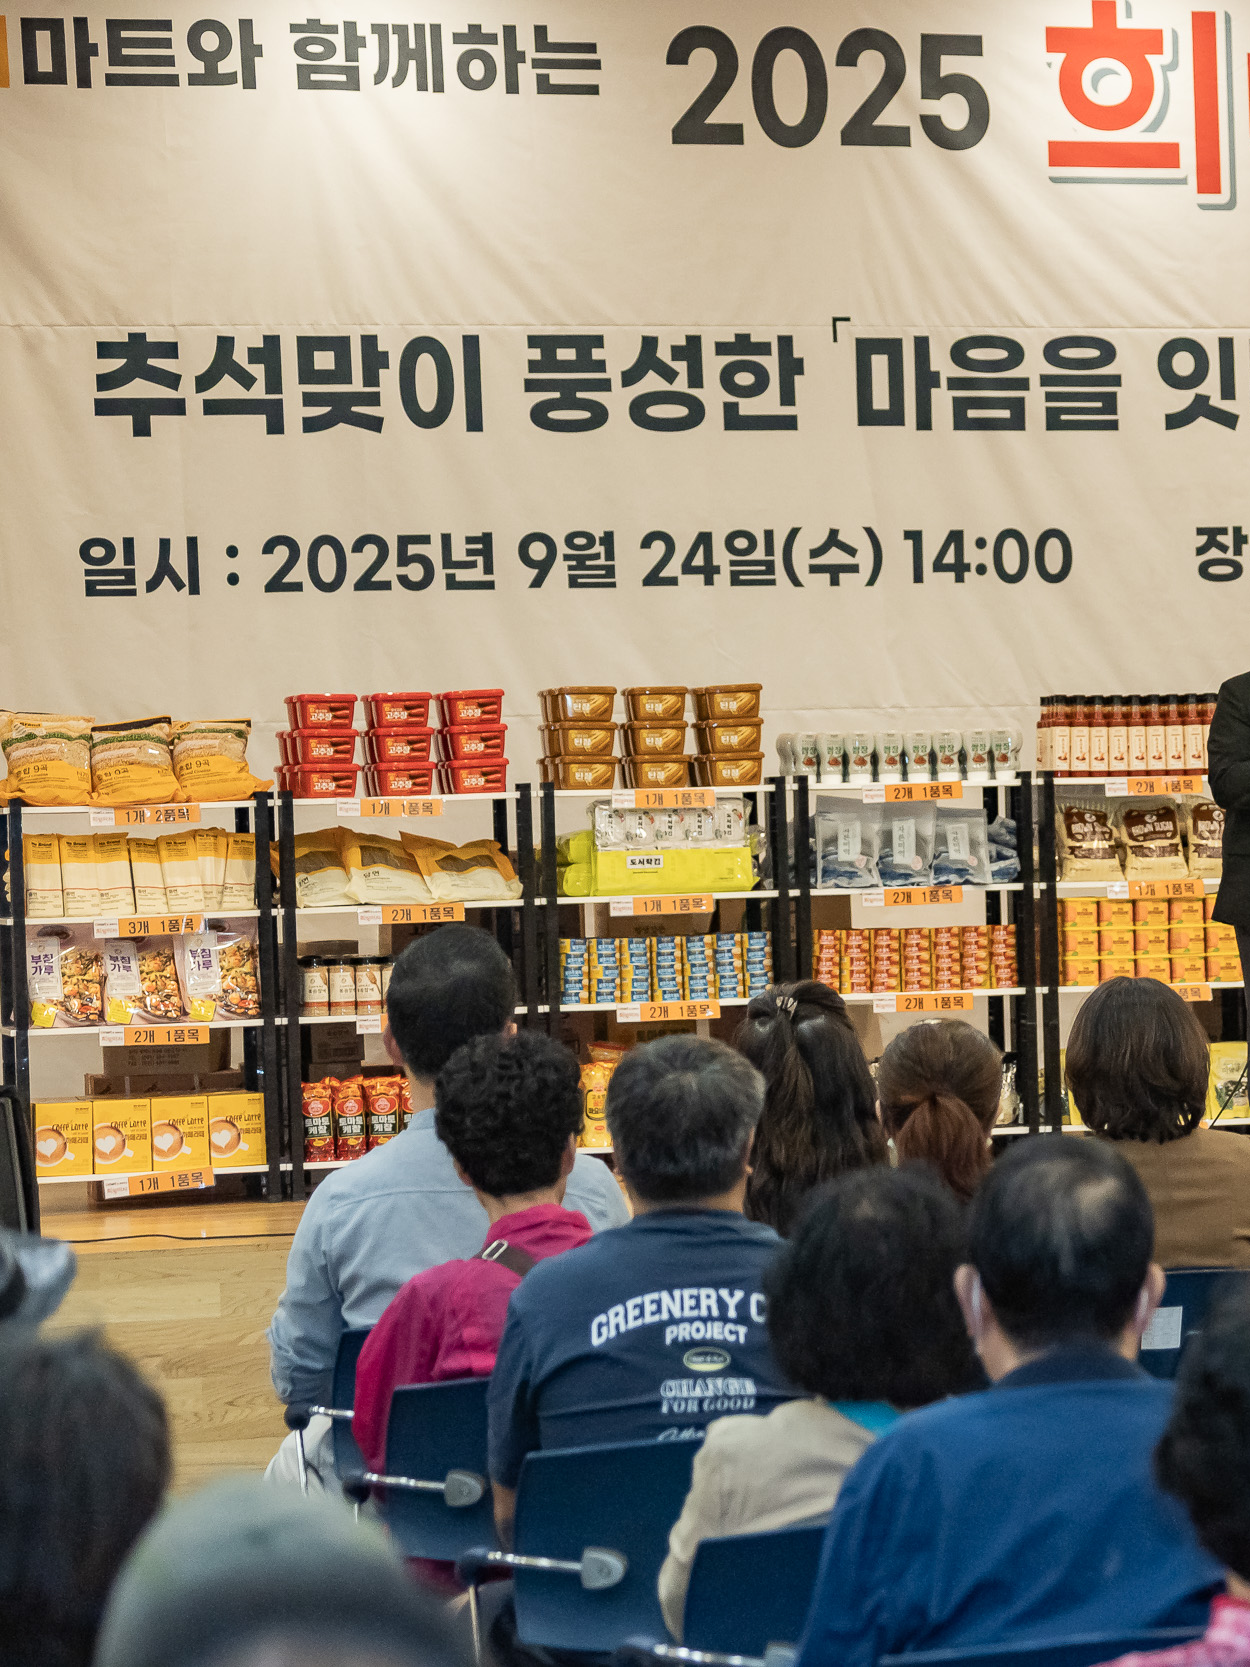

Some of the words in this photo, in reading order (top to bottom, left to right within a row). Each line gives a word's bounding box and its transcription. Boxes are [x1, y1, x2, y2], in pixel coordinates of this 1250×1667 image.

[289, 18, 601, 96] 함께하는
[665, 25, 990, 150] 2025
[93, 331, 485, 437] 추석맞이
[523, 332, 805, 433] 풍성한
[78, 535, 201, 598] 일시
[261, 531, 497, 594] 2025년
[517, 530, 618, 590] 9월
[640, 526, 883, 589] 24일(수)
[902, 528, 1074, 585] 14:00
[311, 712, 333, 722] 고추장
[386, 711, 408, 720] 고추장
[459, 708, 481, 718] 고추장
[312, 747, 334, 756] 고추장
[388, 745, 410, 755] 고추장
[462, 742, 484, 752] 고추장
[313, 781, 336, 791] 고추장
[390, 779, 412, 789] 고추장
[463, 776, 485, 786] 고추장
[1135, 780, 1155, 794] 2개
[1165, 779, 1193, 793] 1품목
[646, 793, 664, 806] 1개
[674, 792, 705, 805] 1품목
[893, 786, 913, 800] 2개
[922, 784, 953, 798] 1품목
[125, 809, 146, 824] 1개
[155, 808, 190, 823] 2품목
[371, 802, 390, 815] 1개
[401, 802, 433, 815] 1품목
[893, 891, 913, 904] 2개
[922, 889, 953, 903] 1품목
[1138, 884, 1156, 897] 1개
[1165, 882, 1195, 897] 1품목
[643, 900, 662, 913] 1개
[672, 897, 703, 911] 1품목
[391, 908, 412, 922] 2개
[421, 906, 455, 921] 1품목
[128, 920, 150, 935] 3개
[160, 918, 194, 933] 1품목
[1178, 988, 1201, 1001] 품목
[905, 997, 924, 1010] 2개
[933, 996, 964, 1009] 1품목
[649, 1006, 669, 1019] 2개
[679, 1004, 710, 1017] 1품목
[134, 1029, 155, 1044] 2개
[166, 1028, 200, 1043] 1품목
[139, 1176, 159, 1192] 1개
[170, 1171, 203, 1188] 1품목
[591, 1287, 746, 1347] GREENERY
[665, 1321, 748, 1346] PROJECT
